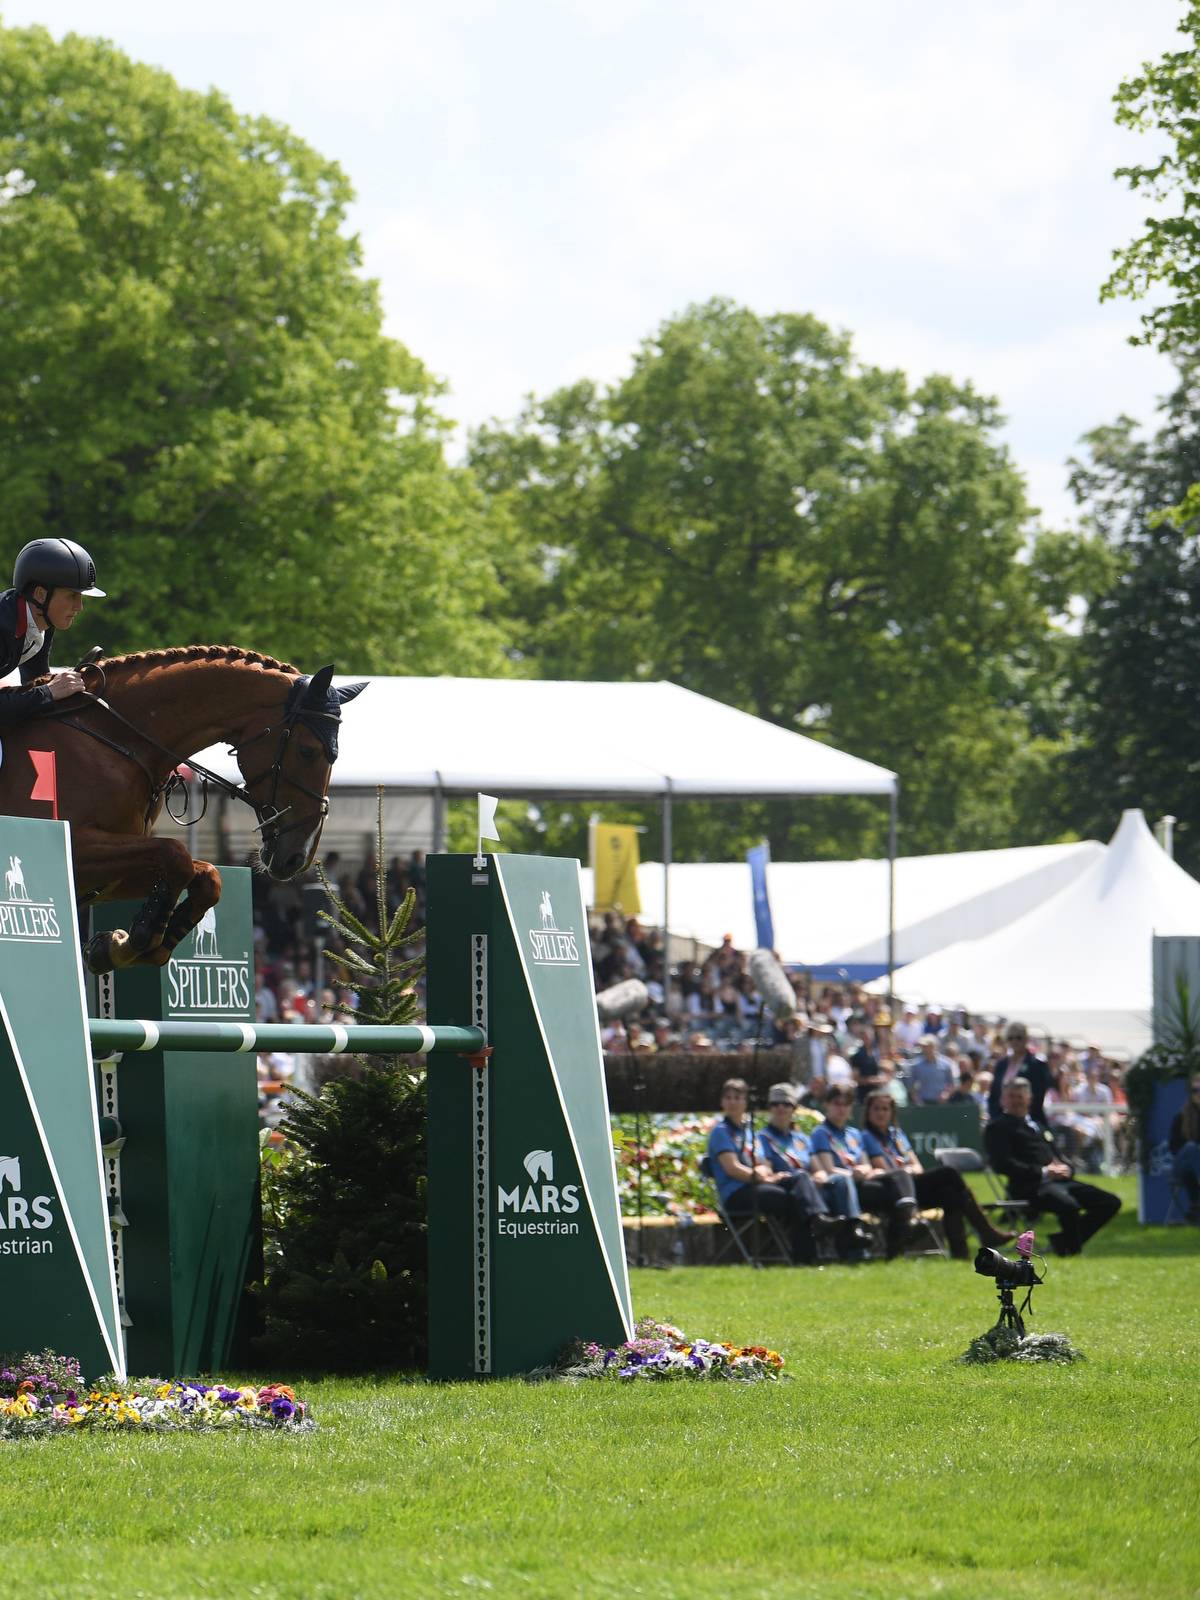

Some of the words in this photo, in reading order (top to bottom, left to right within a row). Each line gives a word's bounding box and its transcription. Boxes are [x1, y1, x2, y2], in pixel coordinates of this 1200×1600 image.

[529, 929, 579, 961] SPILLERS
[167, 957, 250, 1009] SPILLERS
[498, 1184, 580, 1213] MARS
[498, 1218, 579, 1238] Equestrian
